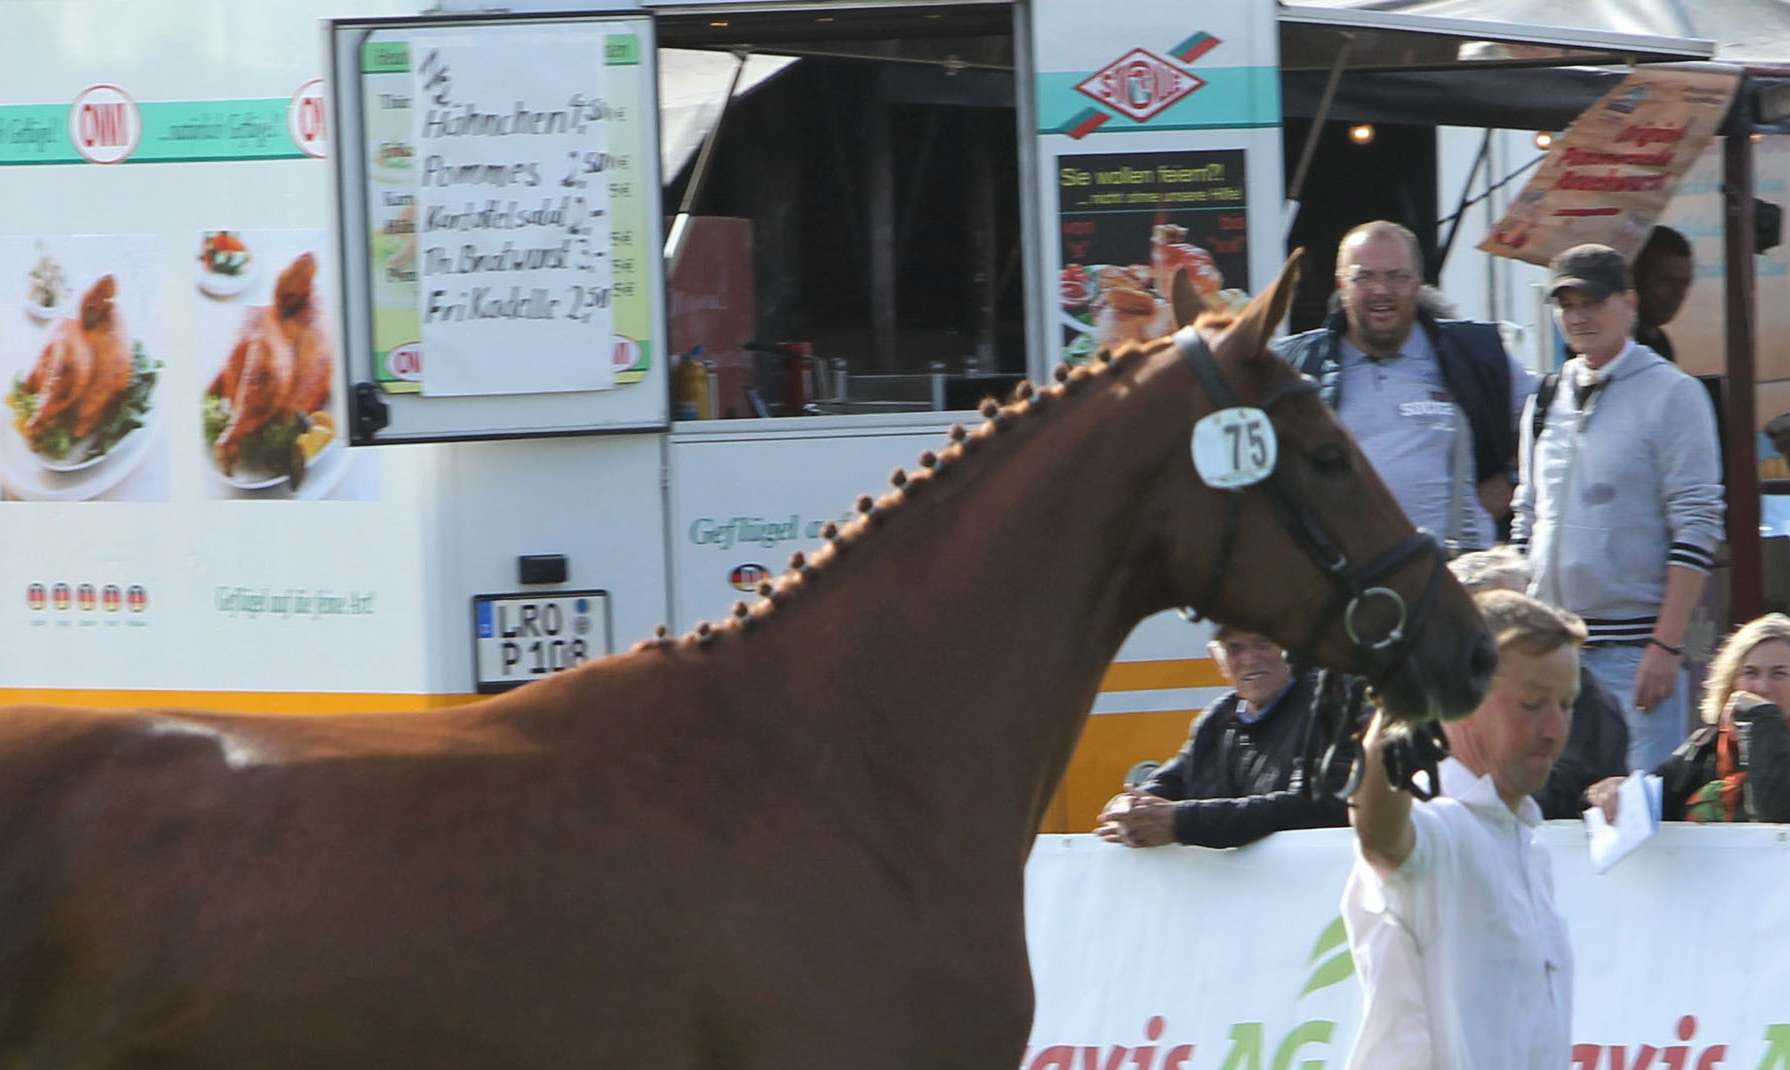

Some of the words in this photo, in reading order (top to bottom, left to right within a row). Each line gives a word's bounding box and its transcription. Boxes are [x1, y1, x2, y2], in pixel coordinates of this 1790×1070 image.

[420, 153, 541, 187] Pommes
[1060, 167, 1092, 186] Sie
[1094, 166, 1155, 185] wollen
[1224, 421, 1268, 471] 75
[689, 513, 800, 550] Geflügel
